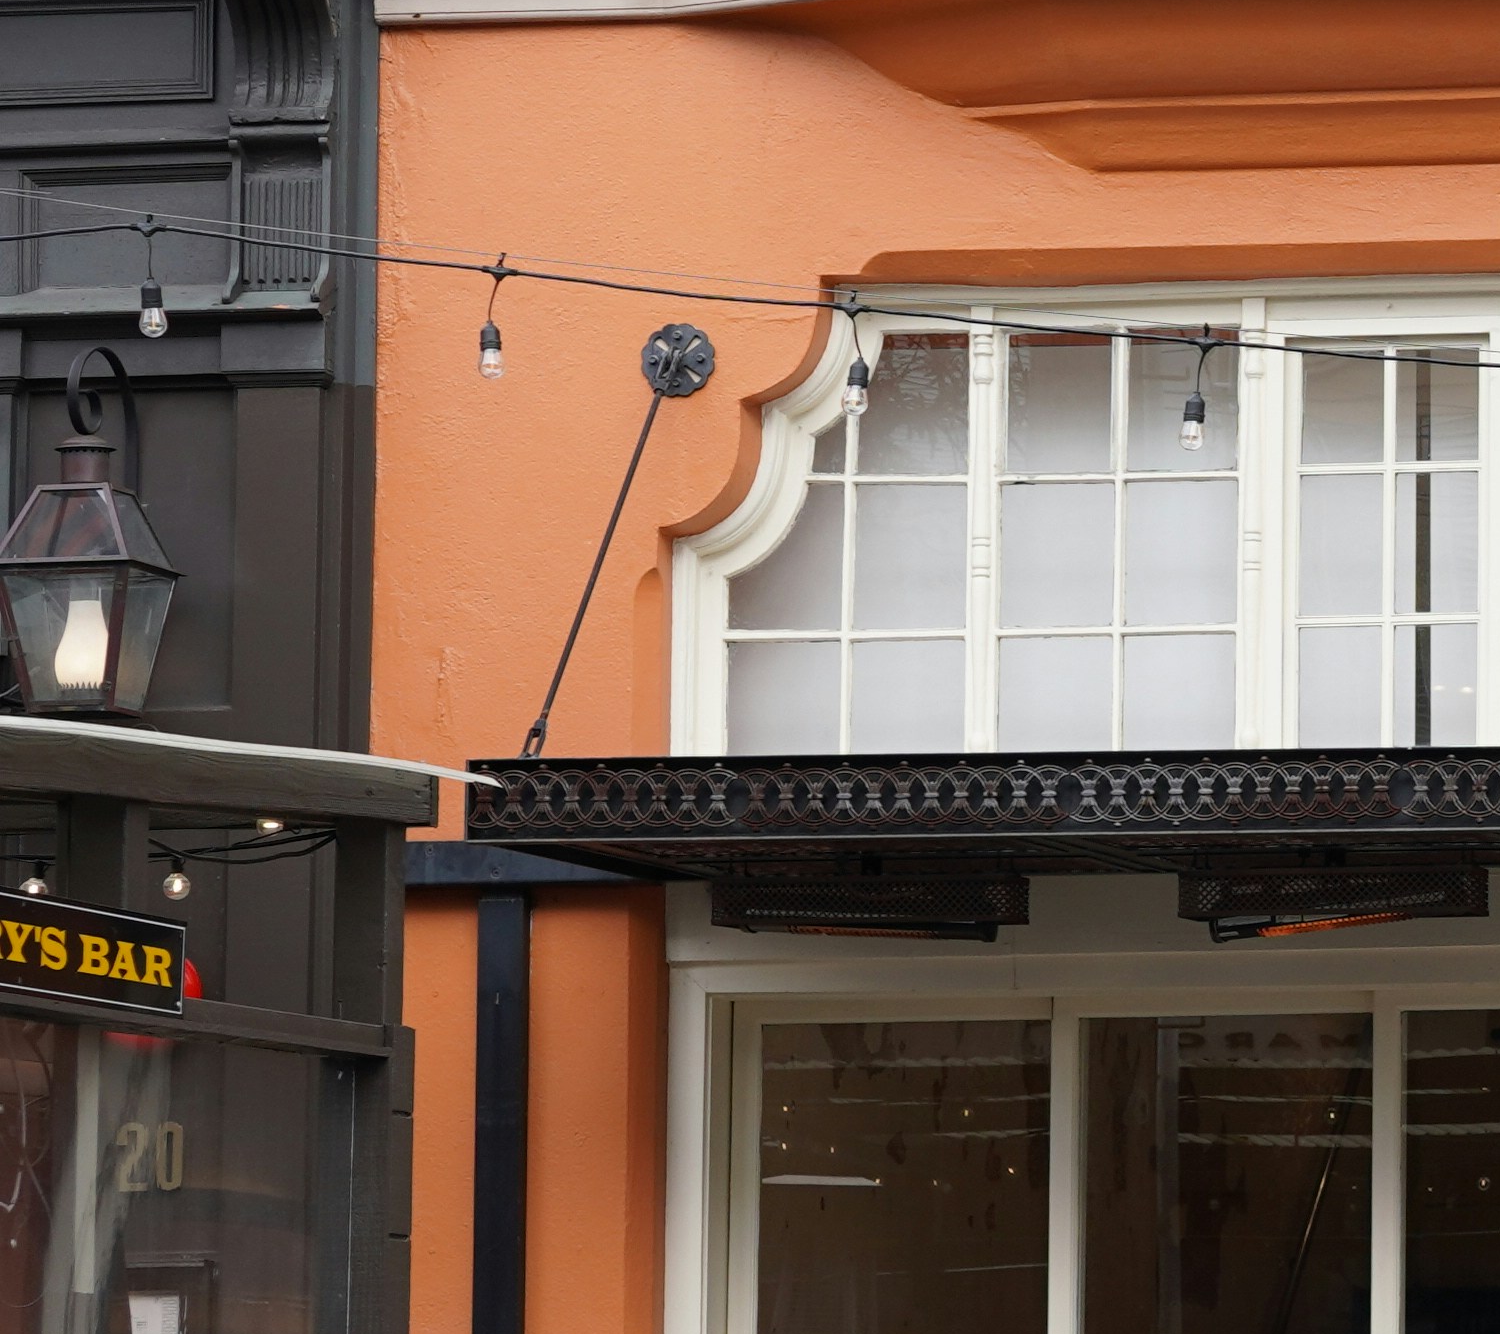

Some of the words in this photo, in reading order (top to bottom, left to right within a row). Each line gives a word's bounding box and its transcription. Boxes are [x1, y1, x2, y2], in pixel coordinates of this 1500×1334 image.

[0, 920, 68, 972] Y'S
[77, 933, 173, 988] BAR
[116, 1121, 184, 1193] 20
